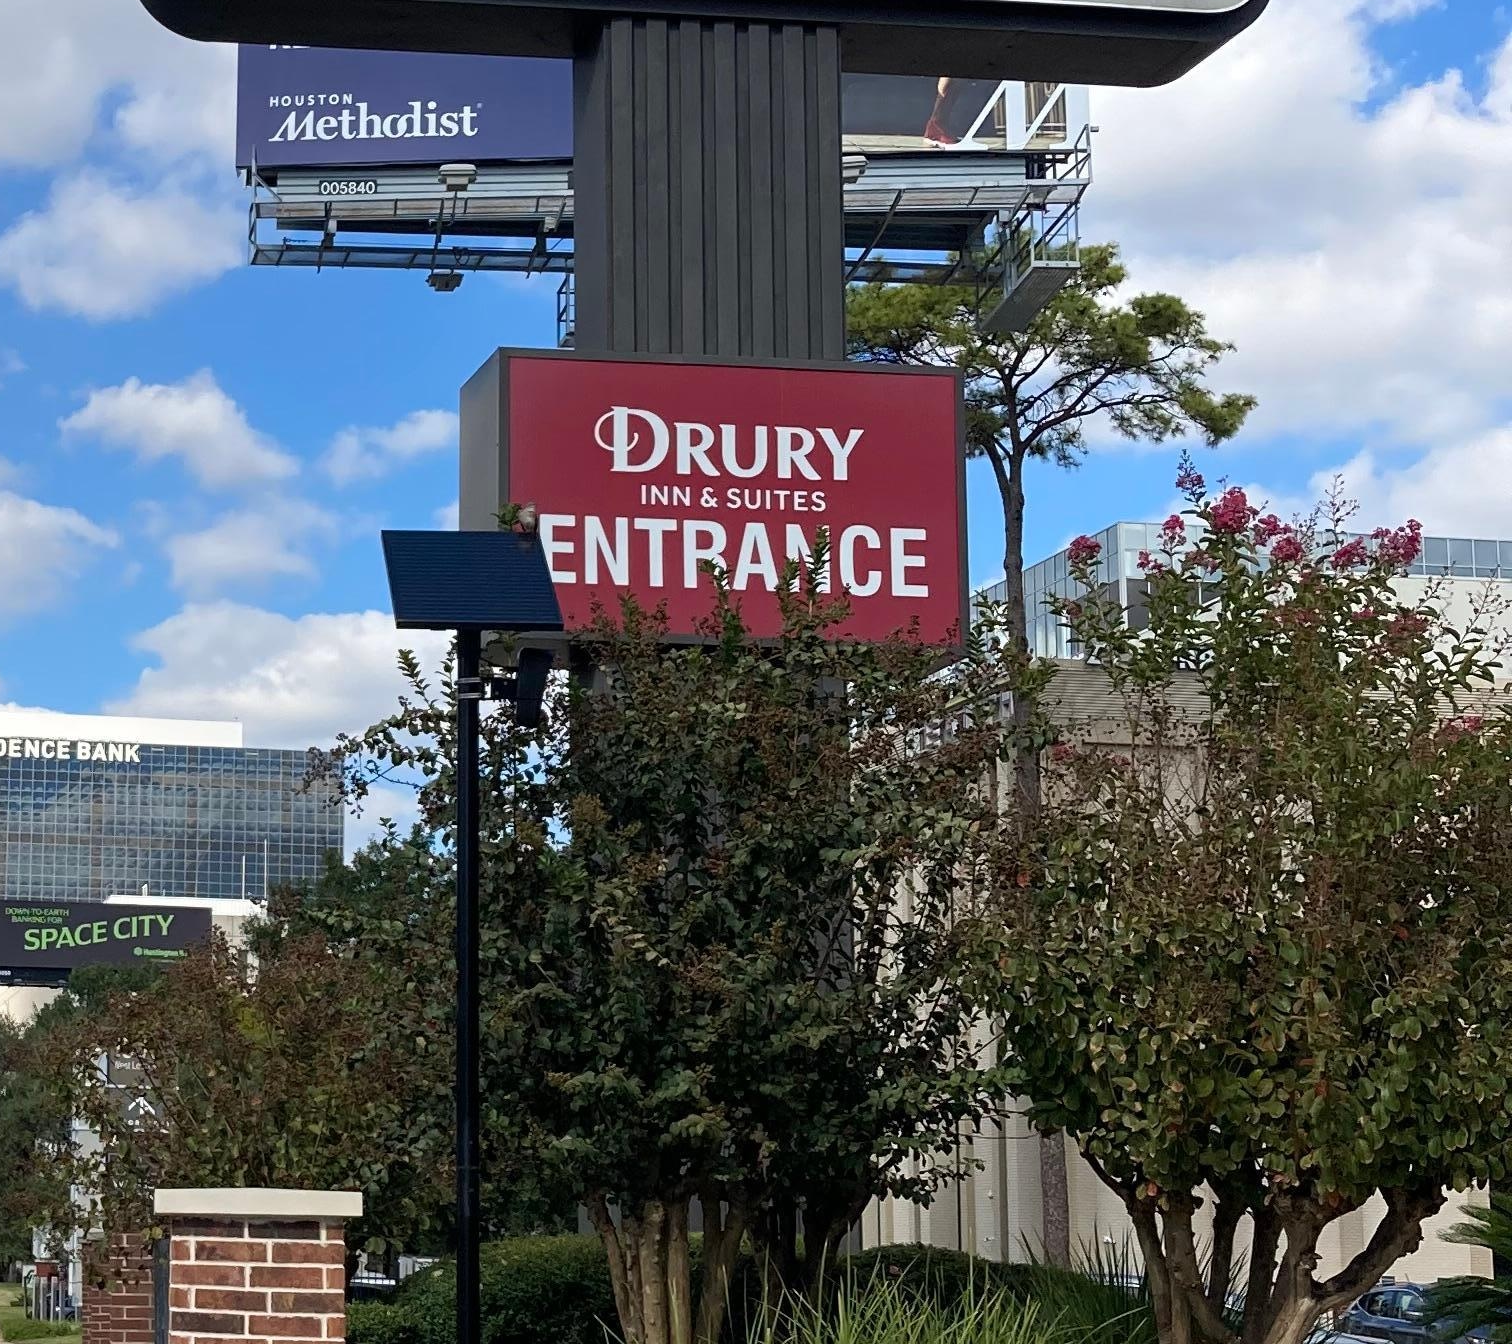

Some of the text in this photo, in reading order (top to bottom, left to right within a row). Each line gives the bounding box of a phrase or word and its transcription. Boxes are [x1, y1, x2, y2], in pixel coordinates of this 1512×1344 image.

[269, 93, 353, 107] HOUSTON
[268, 100, 478, 142] Methodist
[320, 181, 376, 195] 005840
[593, 405, 865, 481] DRURY
[640, 484, 827, 512] INN & SUITES
[539, 513, 930, 598] ENTRANCE
[76, 739, 141, 763] BANK
[23, 914, 175, 951] SPACE CITY
